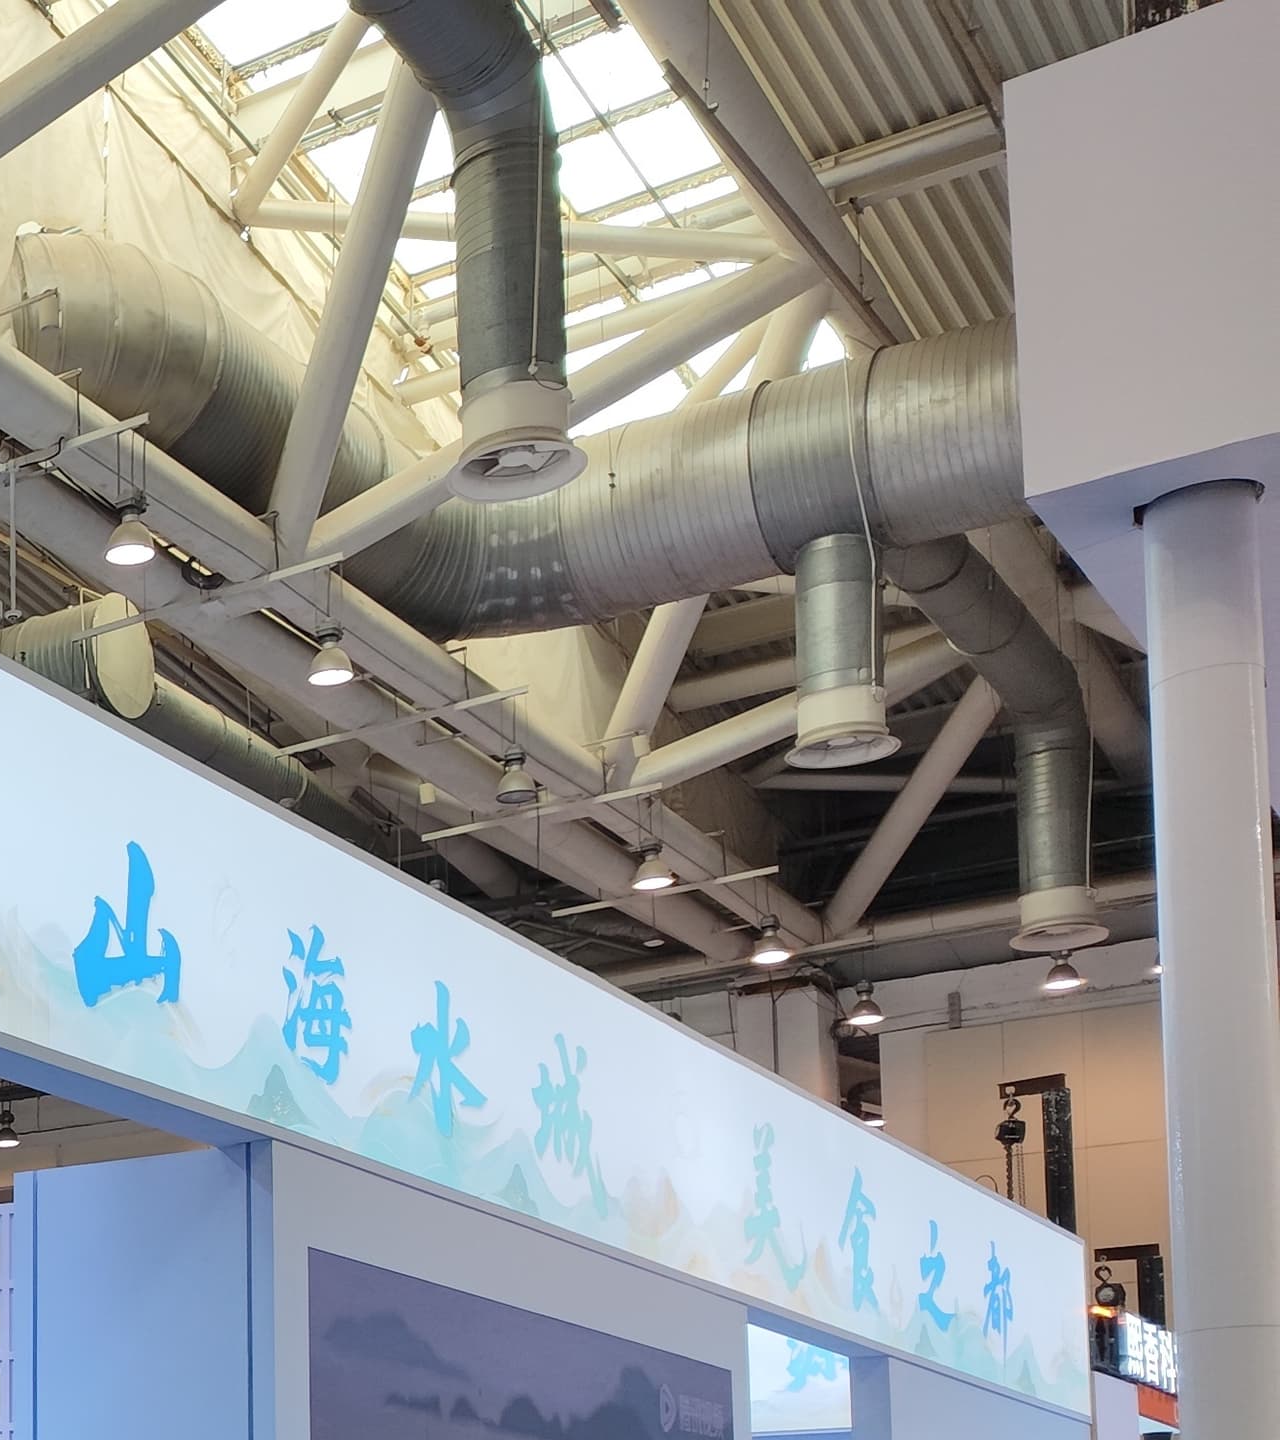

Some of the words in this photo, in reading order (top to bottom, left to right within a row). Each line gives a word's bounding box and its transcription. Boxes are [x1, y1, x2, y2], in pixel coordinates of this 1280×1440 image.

[72, 840, 609, 1220] 山海水城
[742, 1121, 1016, 1372] 美食之都
